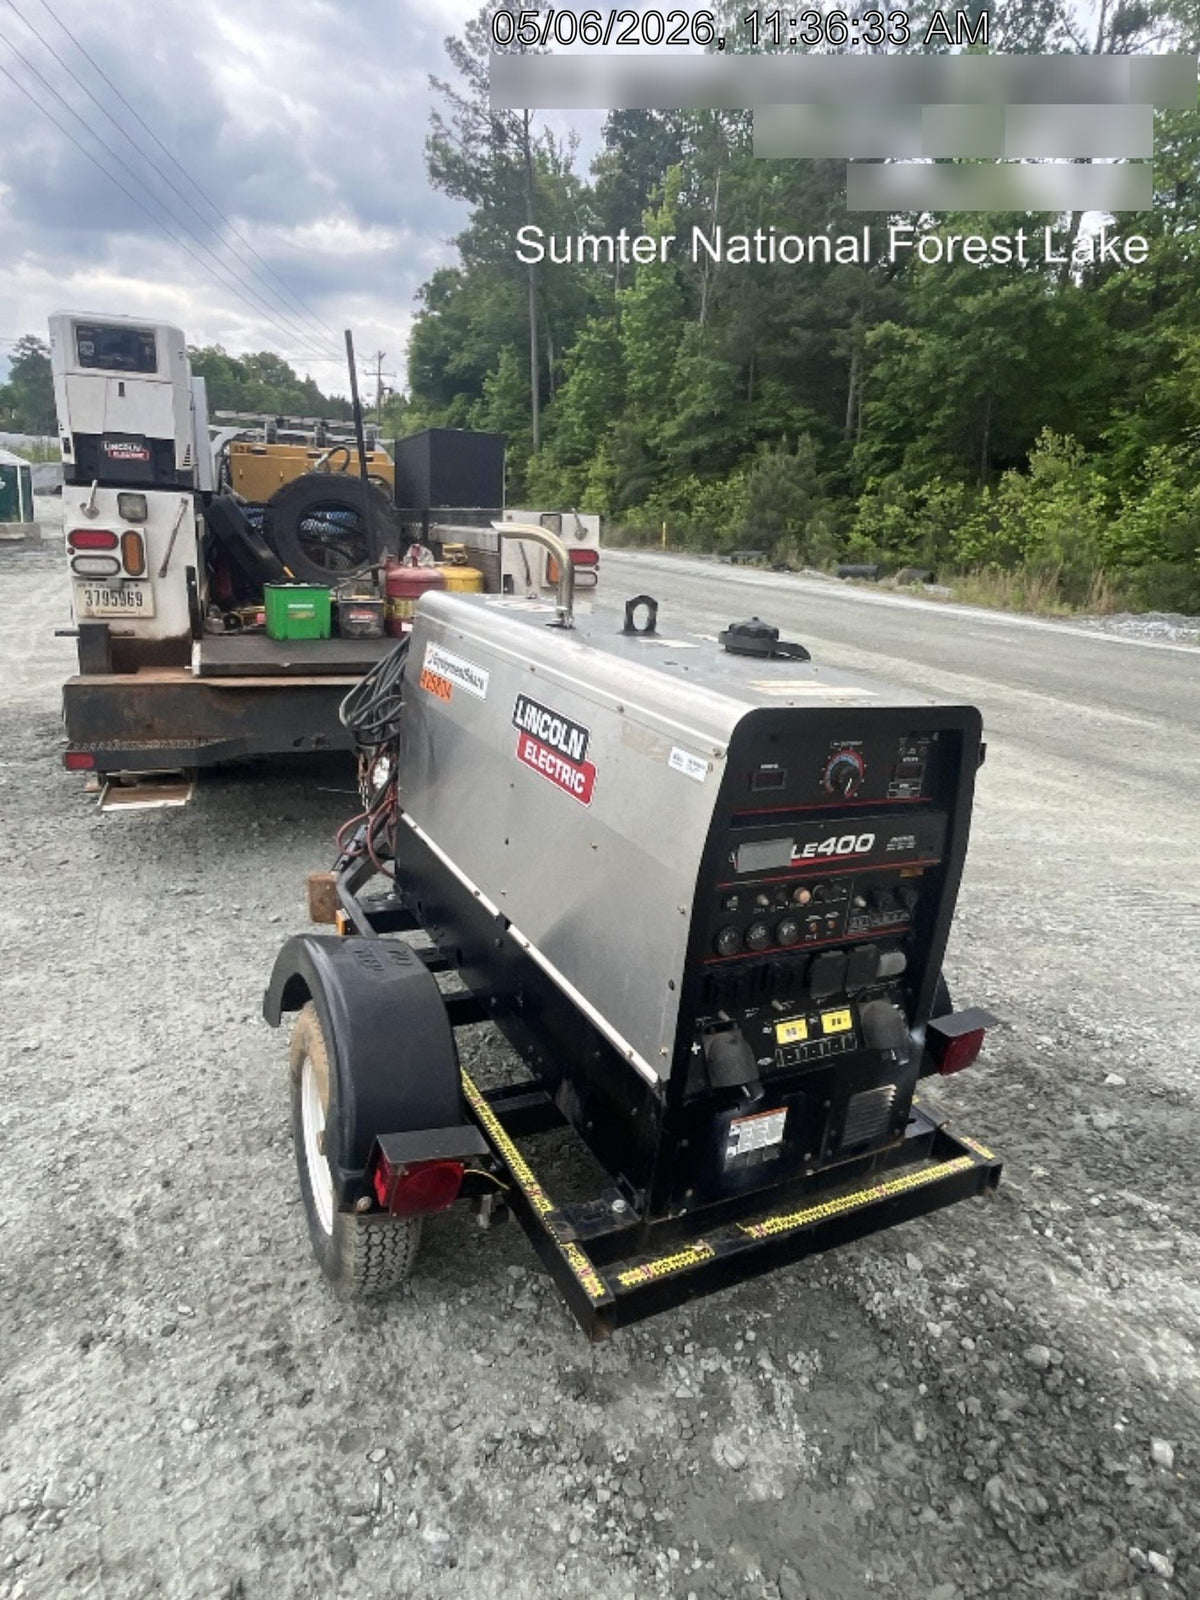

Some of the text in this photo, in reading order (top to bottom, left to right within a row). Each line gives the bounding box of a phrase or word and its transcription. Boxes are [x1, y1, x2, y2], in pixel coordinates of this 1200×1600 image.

[84, 589, 143, 607] 3795969
[515, 700, 585, 760] LINCOLN
[524, 740, 586, 794] ELECTRIC
